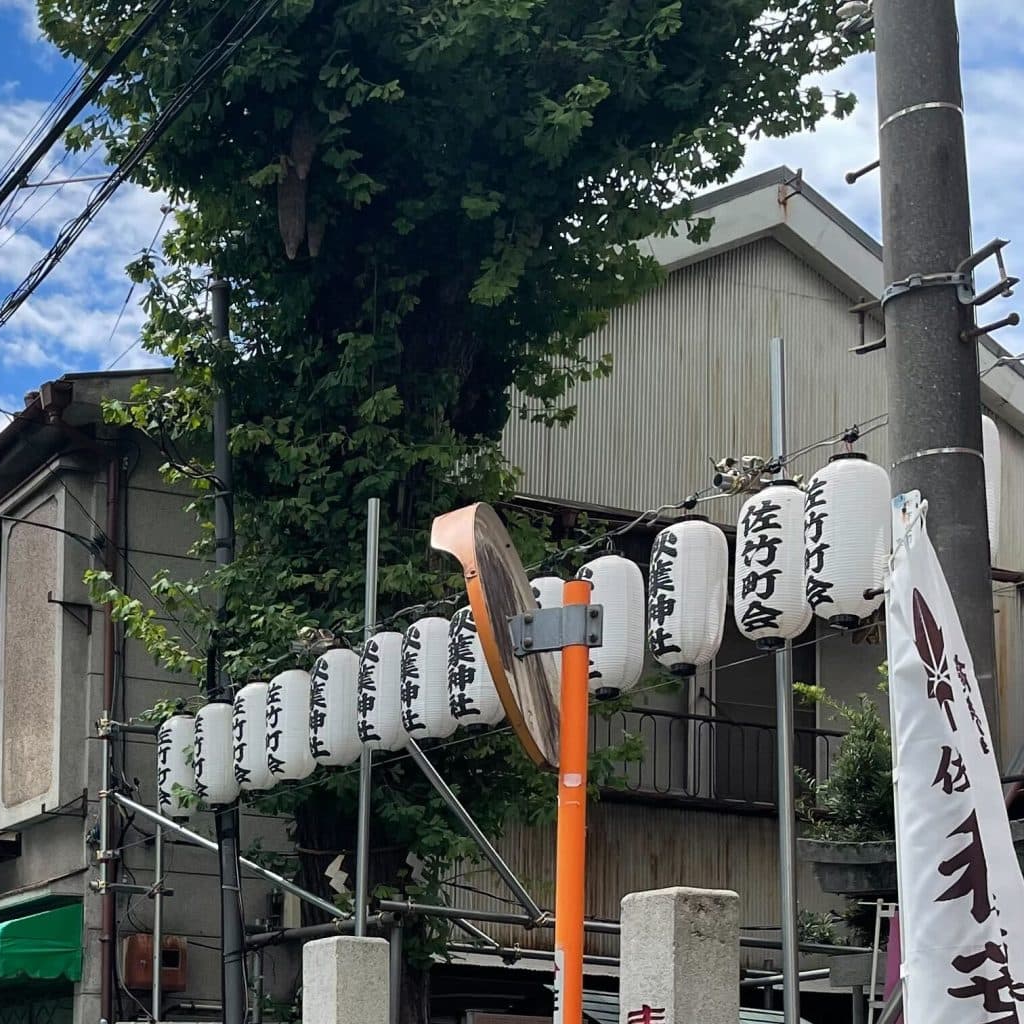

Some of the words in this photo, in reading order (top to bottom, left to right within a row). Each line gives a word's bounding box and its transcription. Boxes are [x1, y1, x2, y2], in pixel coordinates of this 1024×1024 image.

[648, 530, 681, 659] 秋葉神社
[741, 500, 783, 633] 佐竹町会
[448, 608, 481, 720] 秋葉神社
